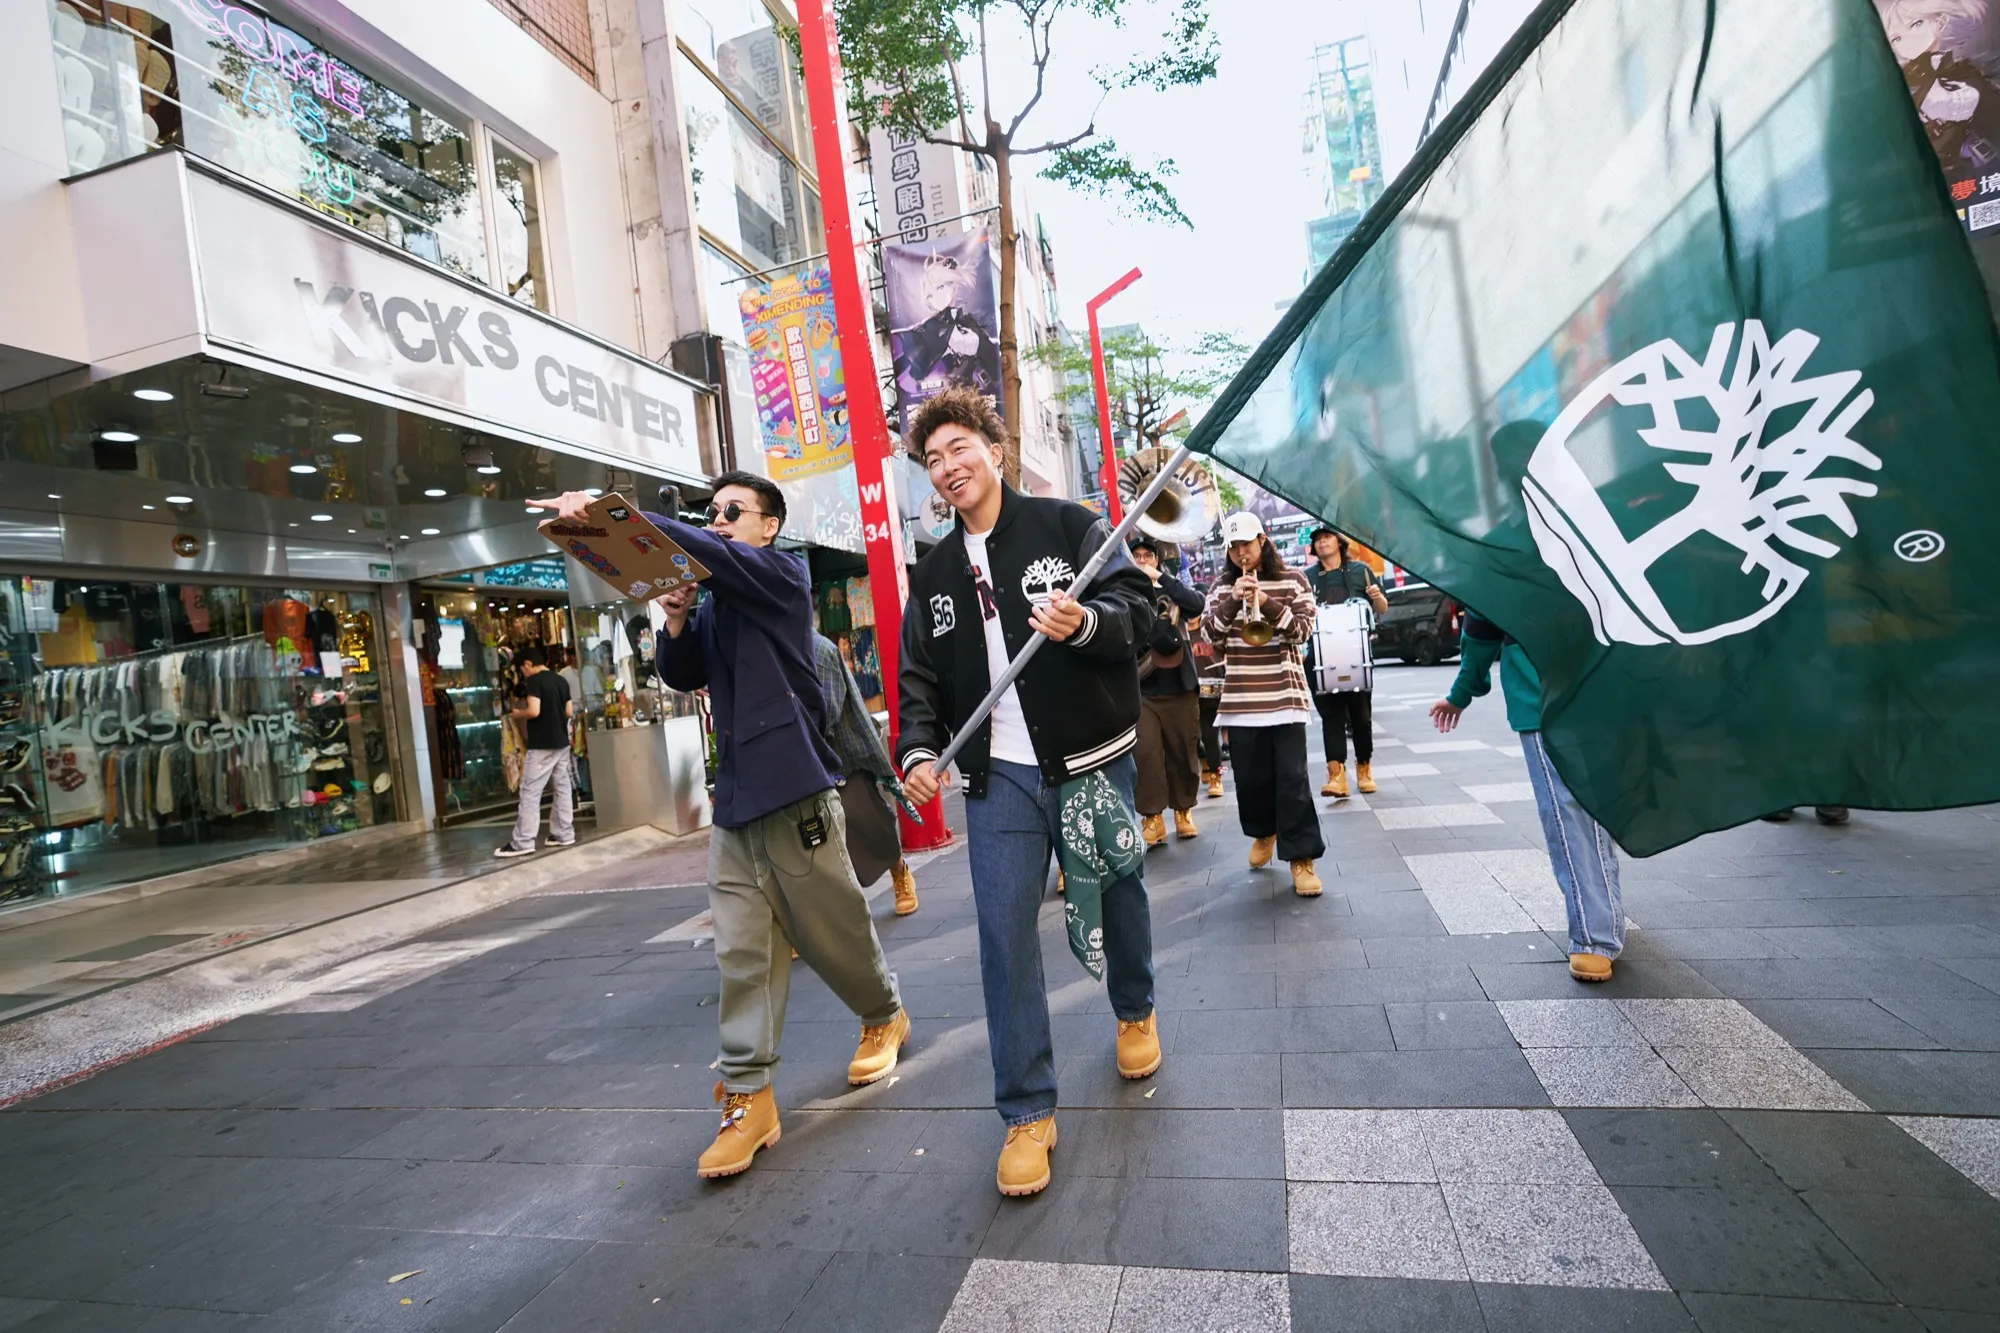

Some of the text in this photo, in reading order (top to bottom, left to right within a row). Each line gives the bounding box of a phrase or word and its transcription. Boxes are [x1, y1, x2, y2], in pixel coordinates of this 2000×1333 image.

[242, 67, 327, 142] AS
[751, 279, 821, 308] WELCOME TO
[755, 293, 825, 325] XIMENDING
[534, 355, 689, 449] CENTER
[860, 482, 882, 505] W
[865, 520, 890, 542] 34
[931, 595, 954, 629] 56
[185, 709, 299, 754] CENTER
